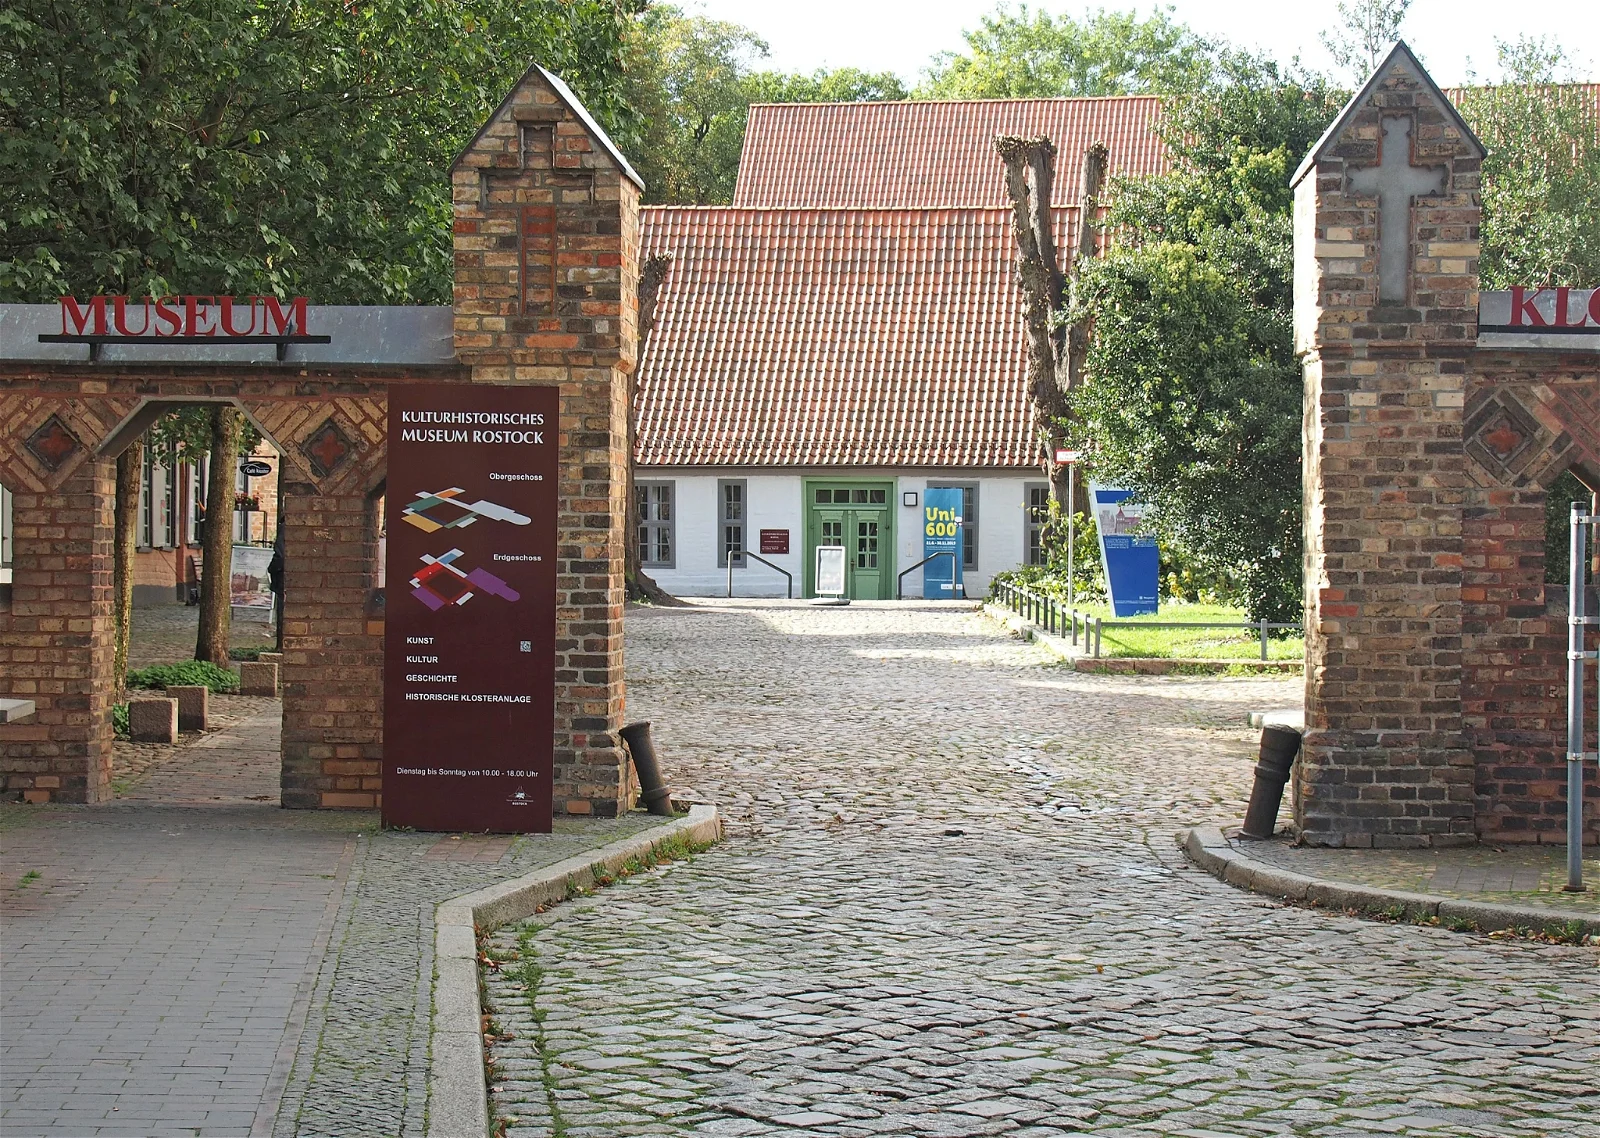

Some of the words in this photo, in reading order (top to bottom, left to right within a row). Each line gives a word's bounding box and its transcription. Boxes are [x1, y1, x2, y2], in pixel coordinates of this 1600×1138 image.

[59, 295, 310, 337] MUSEUM
[402, 411, 544, 425] KULTURHISTORISCHES
[401, 429, 468, 443] MUSEUM
[473, 430, 544, 444] ROSTOCK
[489, 472, 543, 482] Obergeschoss
[926, 507, 955, 521] Uni
[925, 522, 957, 537] 600
[493, 554, 542, 562] Erdgeschoss
[406, 637, 435, 645] KUNST
[406, 656, 439, 664] KULTUR
[406, 674, 458, 683] GESCHICHTE
[405, 693, 459, 702] HISTORISCHE
[460, 694, 532, 703] KLOSTERANLAGE
[396, 767, 426, 776] Dienstag
[438, 769, 467, 777] Sonntag
[481, 769, 500, 777] 10.00
